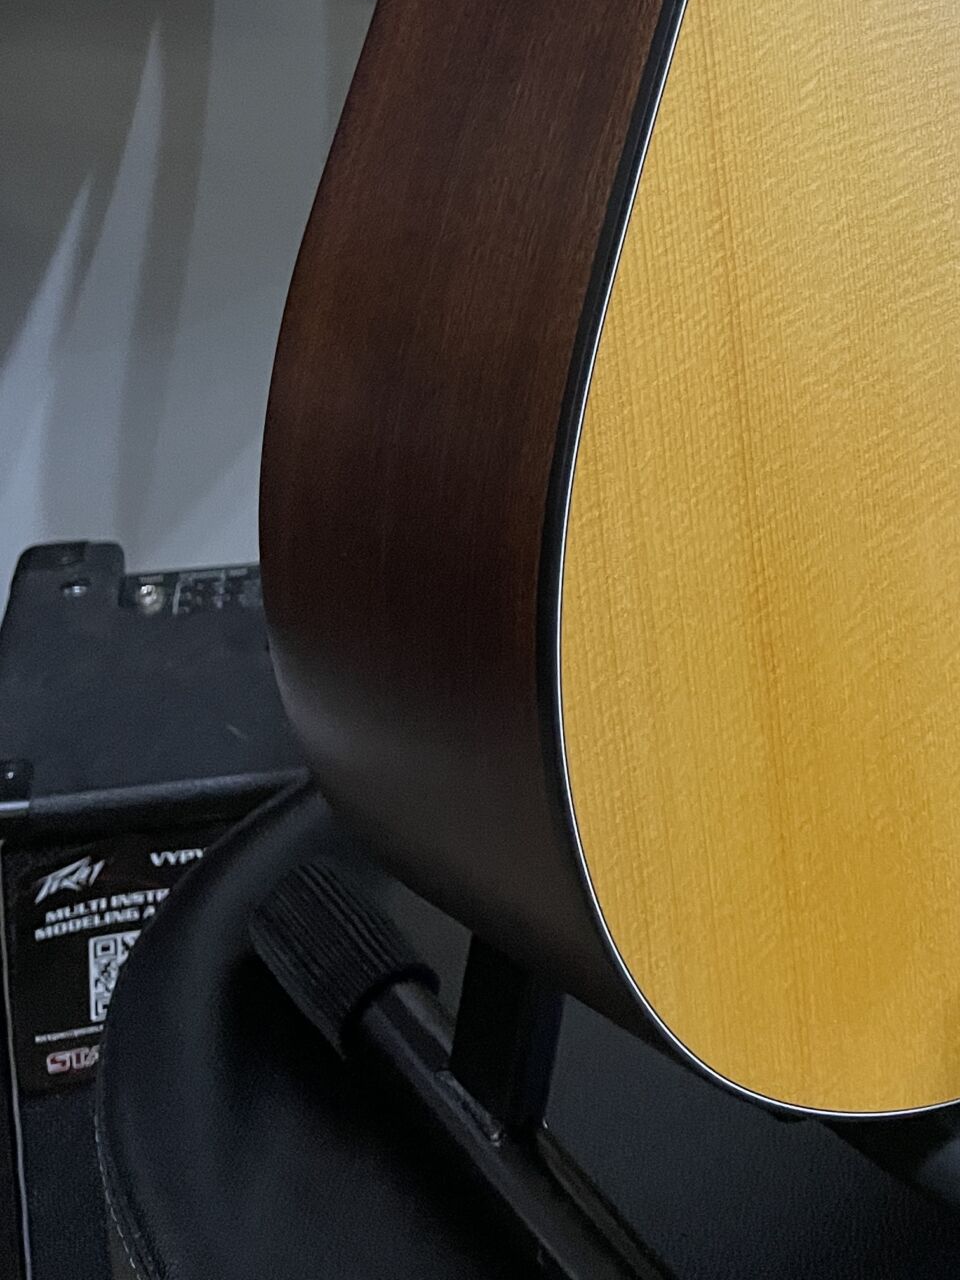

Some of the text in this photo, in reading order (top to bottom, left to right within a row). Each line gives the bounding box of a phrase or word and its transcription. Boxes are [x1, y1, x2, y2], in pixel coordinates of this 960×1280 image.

[35, 906, 140, 941] MODELING
[45, 888, 170, 924] MULTI INSTR
